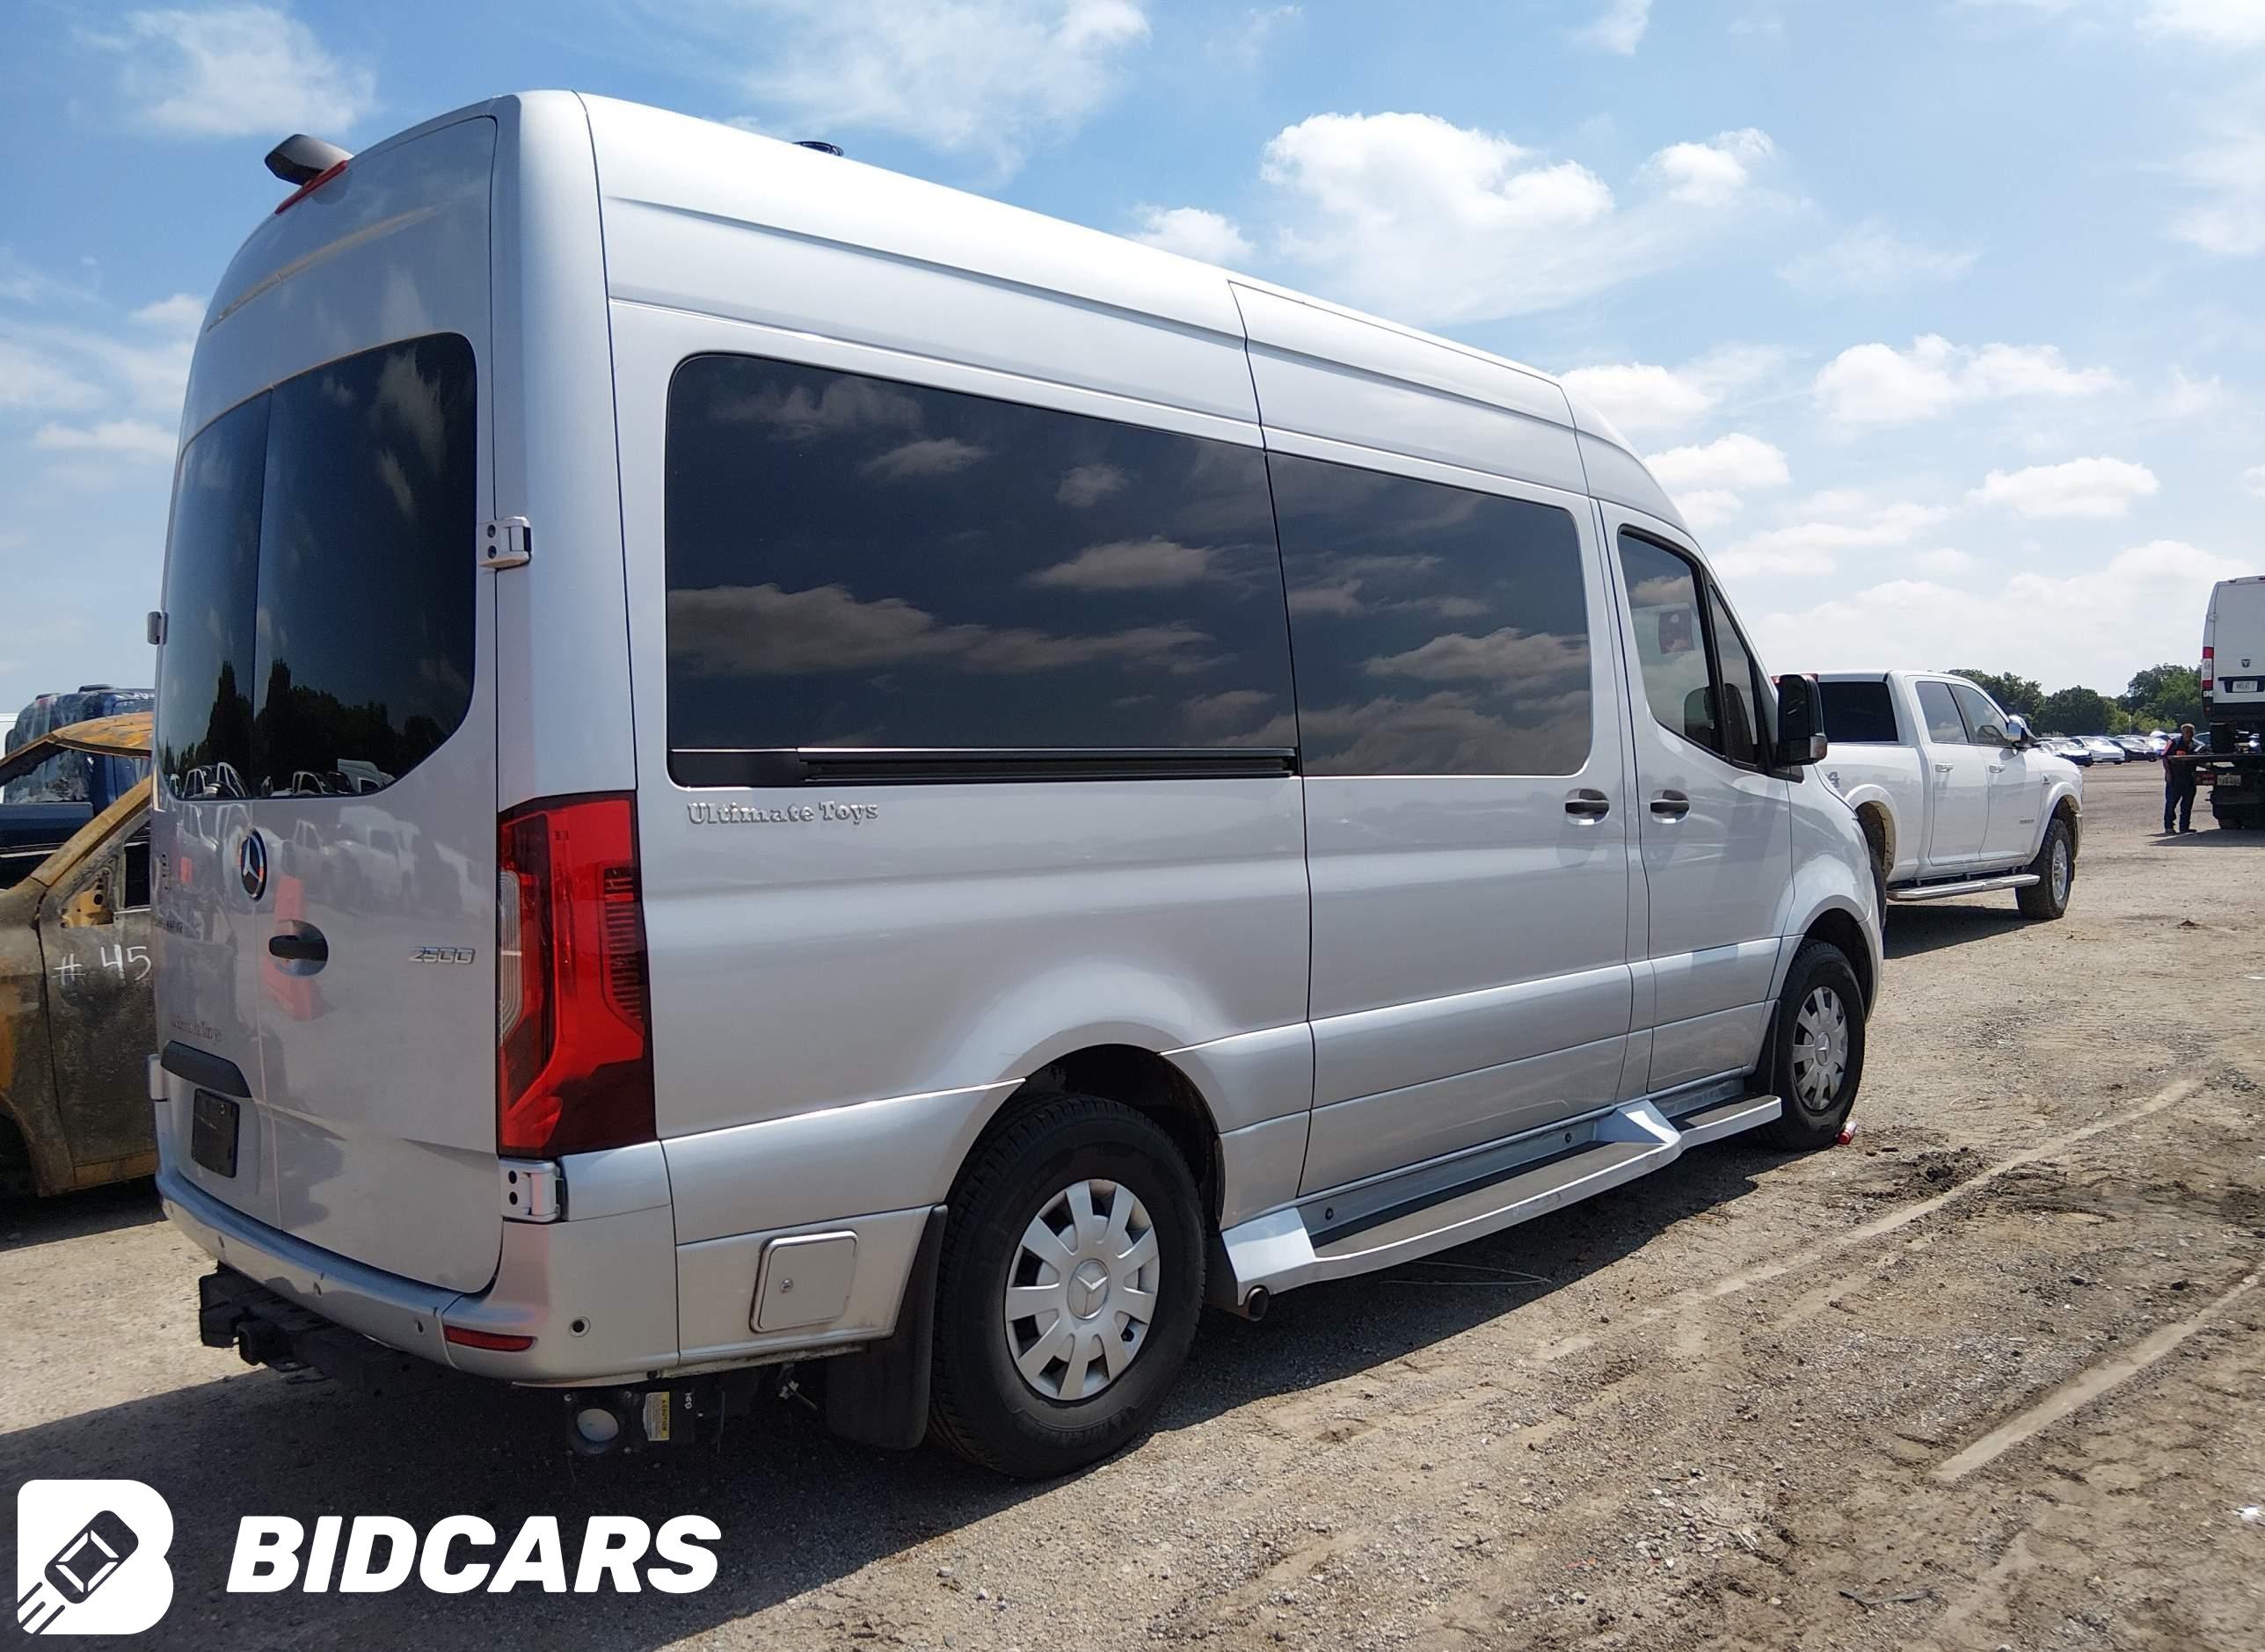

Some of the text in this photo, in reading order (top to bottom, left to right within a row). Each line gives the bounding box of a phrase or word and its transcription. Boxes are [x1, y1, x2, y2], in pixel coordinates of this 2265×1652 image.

[688, 801, 879, 825] Ultimate Toys
[100, 943, 151, 985] 45
[409, 946, 476, 964] 2500
